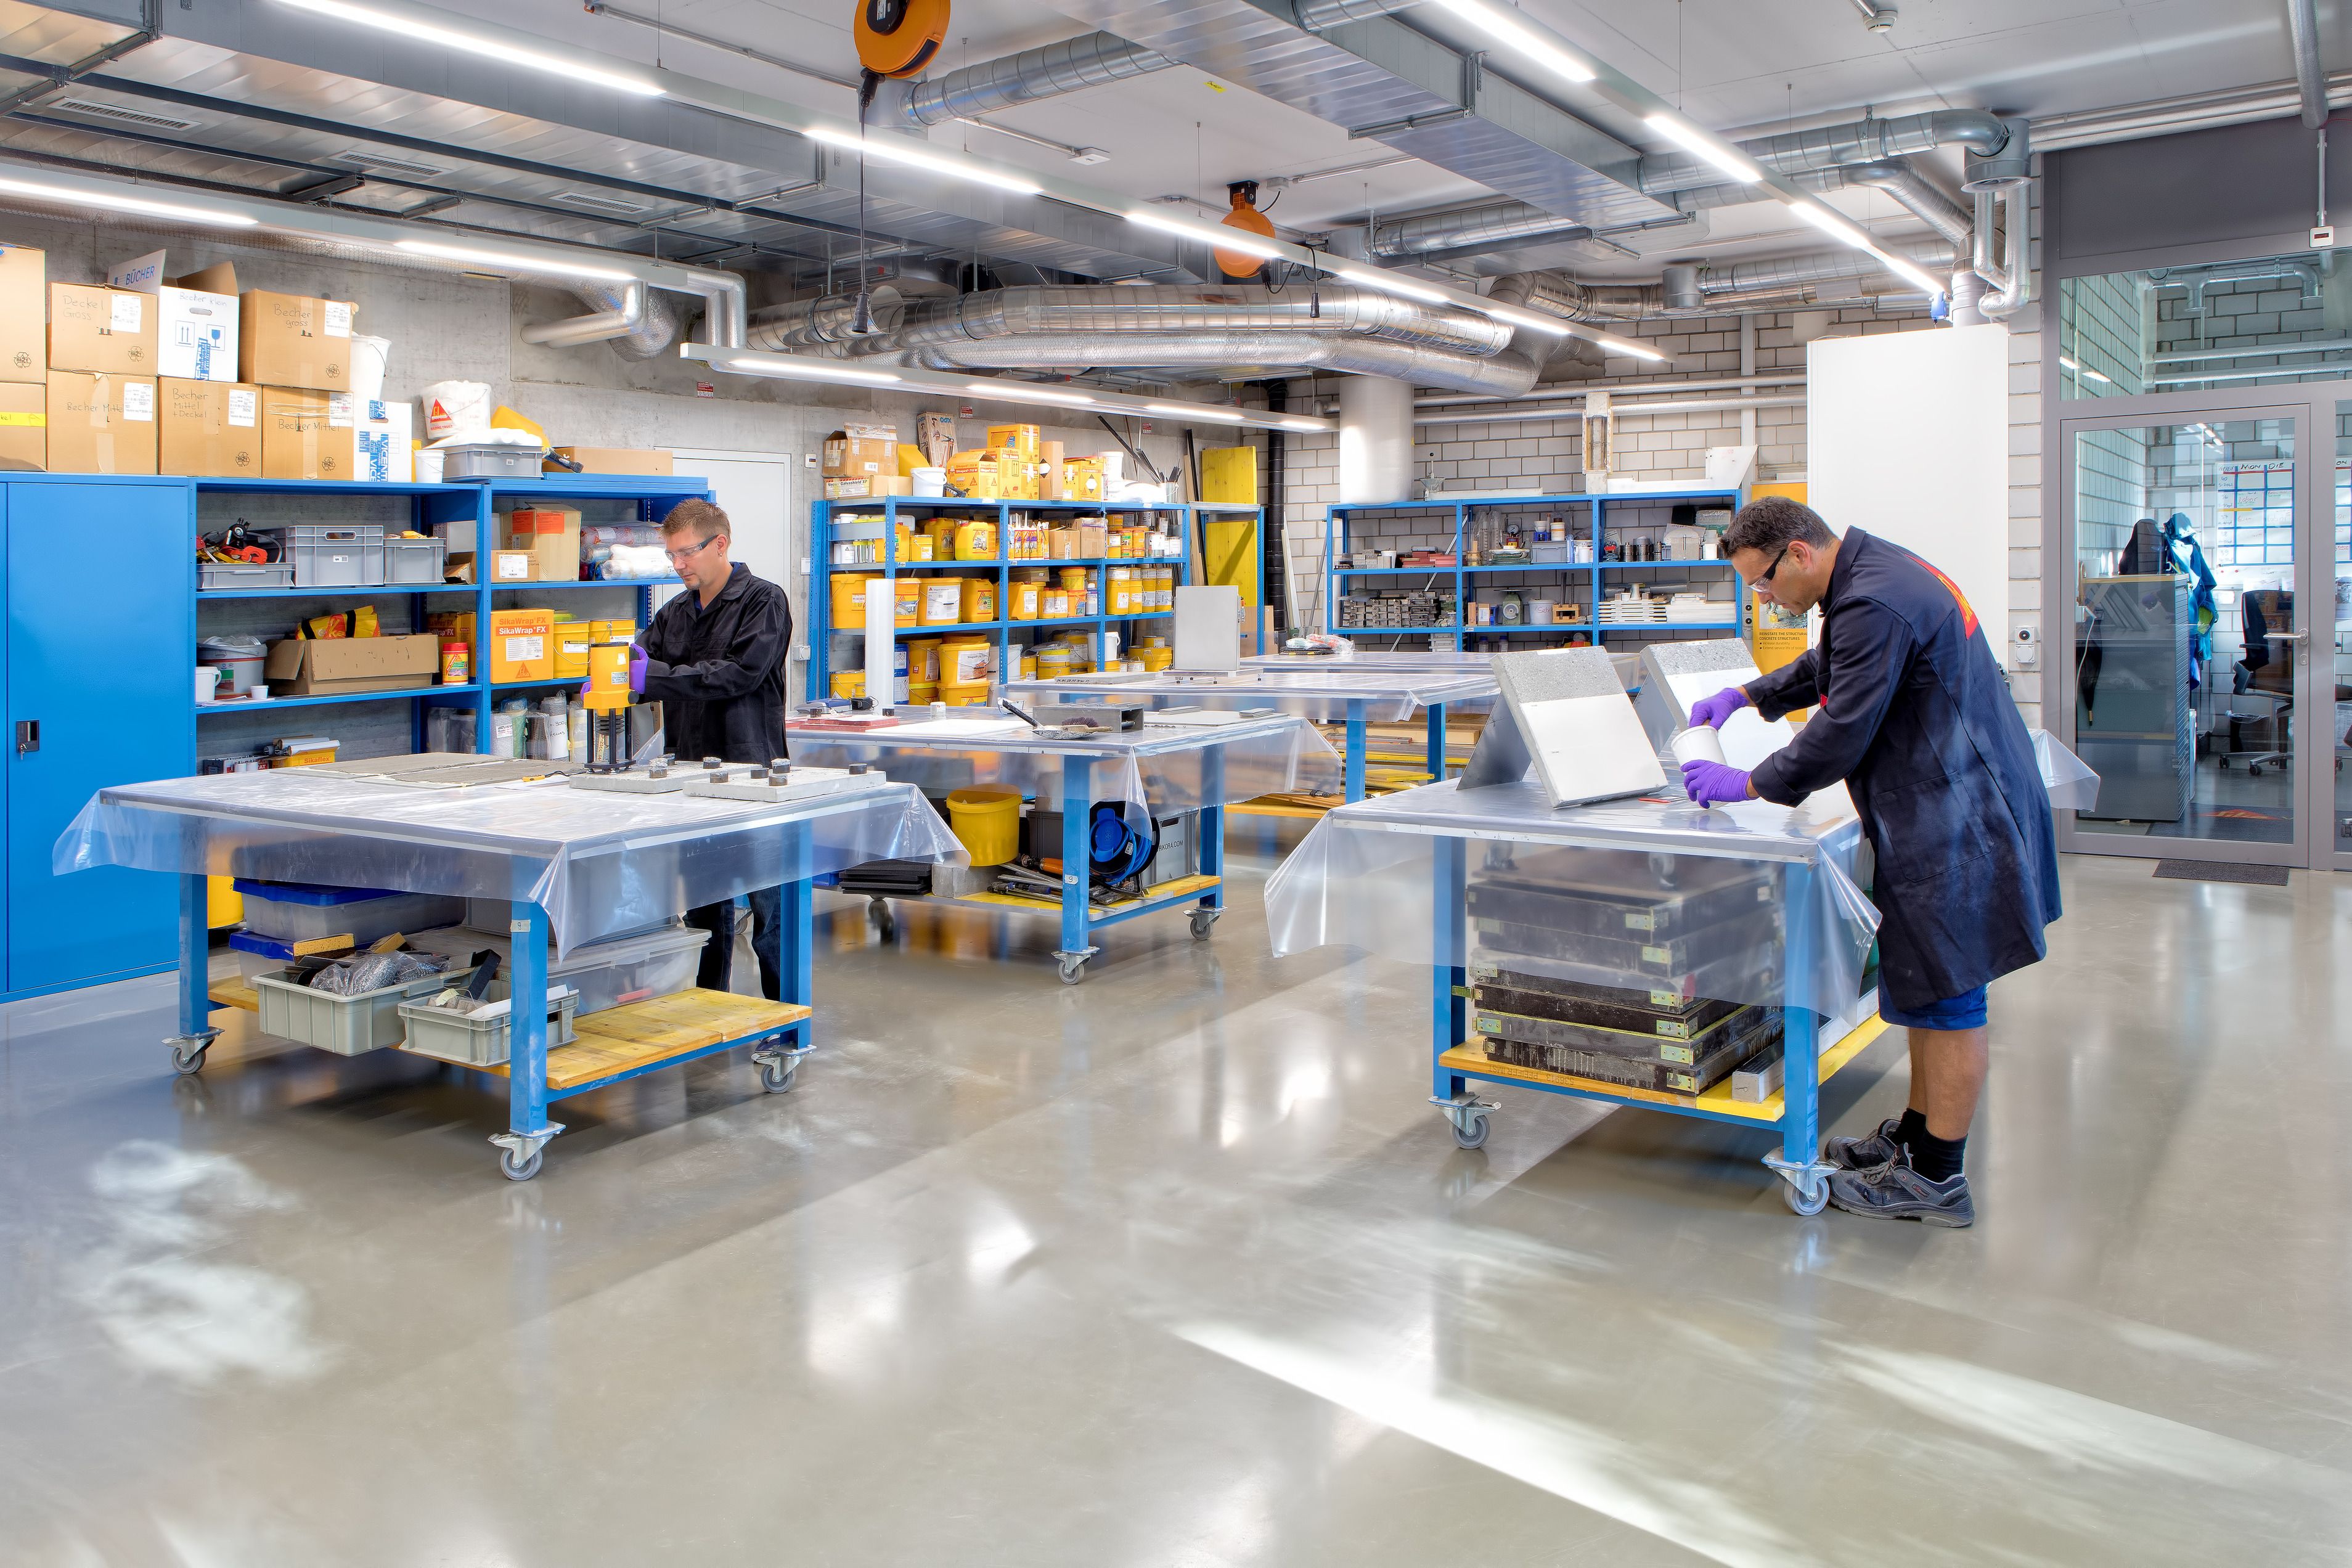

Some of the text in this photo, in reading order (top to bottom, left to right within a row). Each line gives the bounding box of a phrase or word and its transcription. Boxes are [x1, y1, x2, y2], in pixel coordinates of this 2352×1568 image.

[125, 266, 155, 285] BÜCHER
[62, 295, 104, 311] Deckel
[179, 292, 206, 303] Becher
[63, 308, 92, 321] Gross
[274, 303, 311, 319] Becher
[285, 319, 308, 329] gross
[173, 388, 209, 401] Becher
[67, 401, 124, 412] Becher Mitte
[174, 401, 200, 410] Mittel
[278, 419, 340, 431] Becher Mittel
[1159, 839, 1183, 851] RIKORA.COM
[1487, 1064, 1505, 1074] IMST
[1507, 1066, 1538, 1080] PFEIFER
